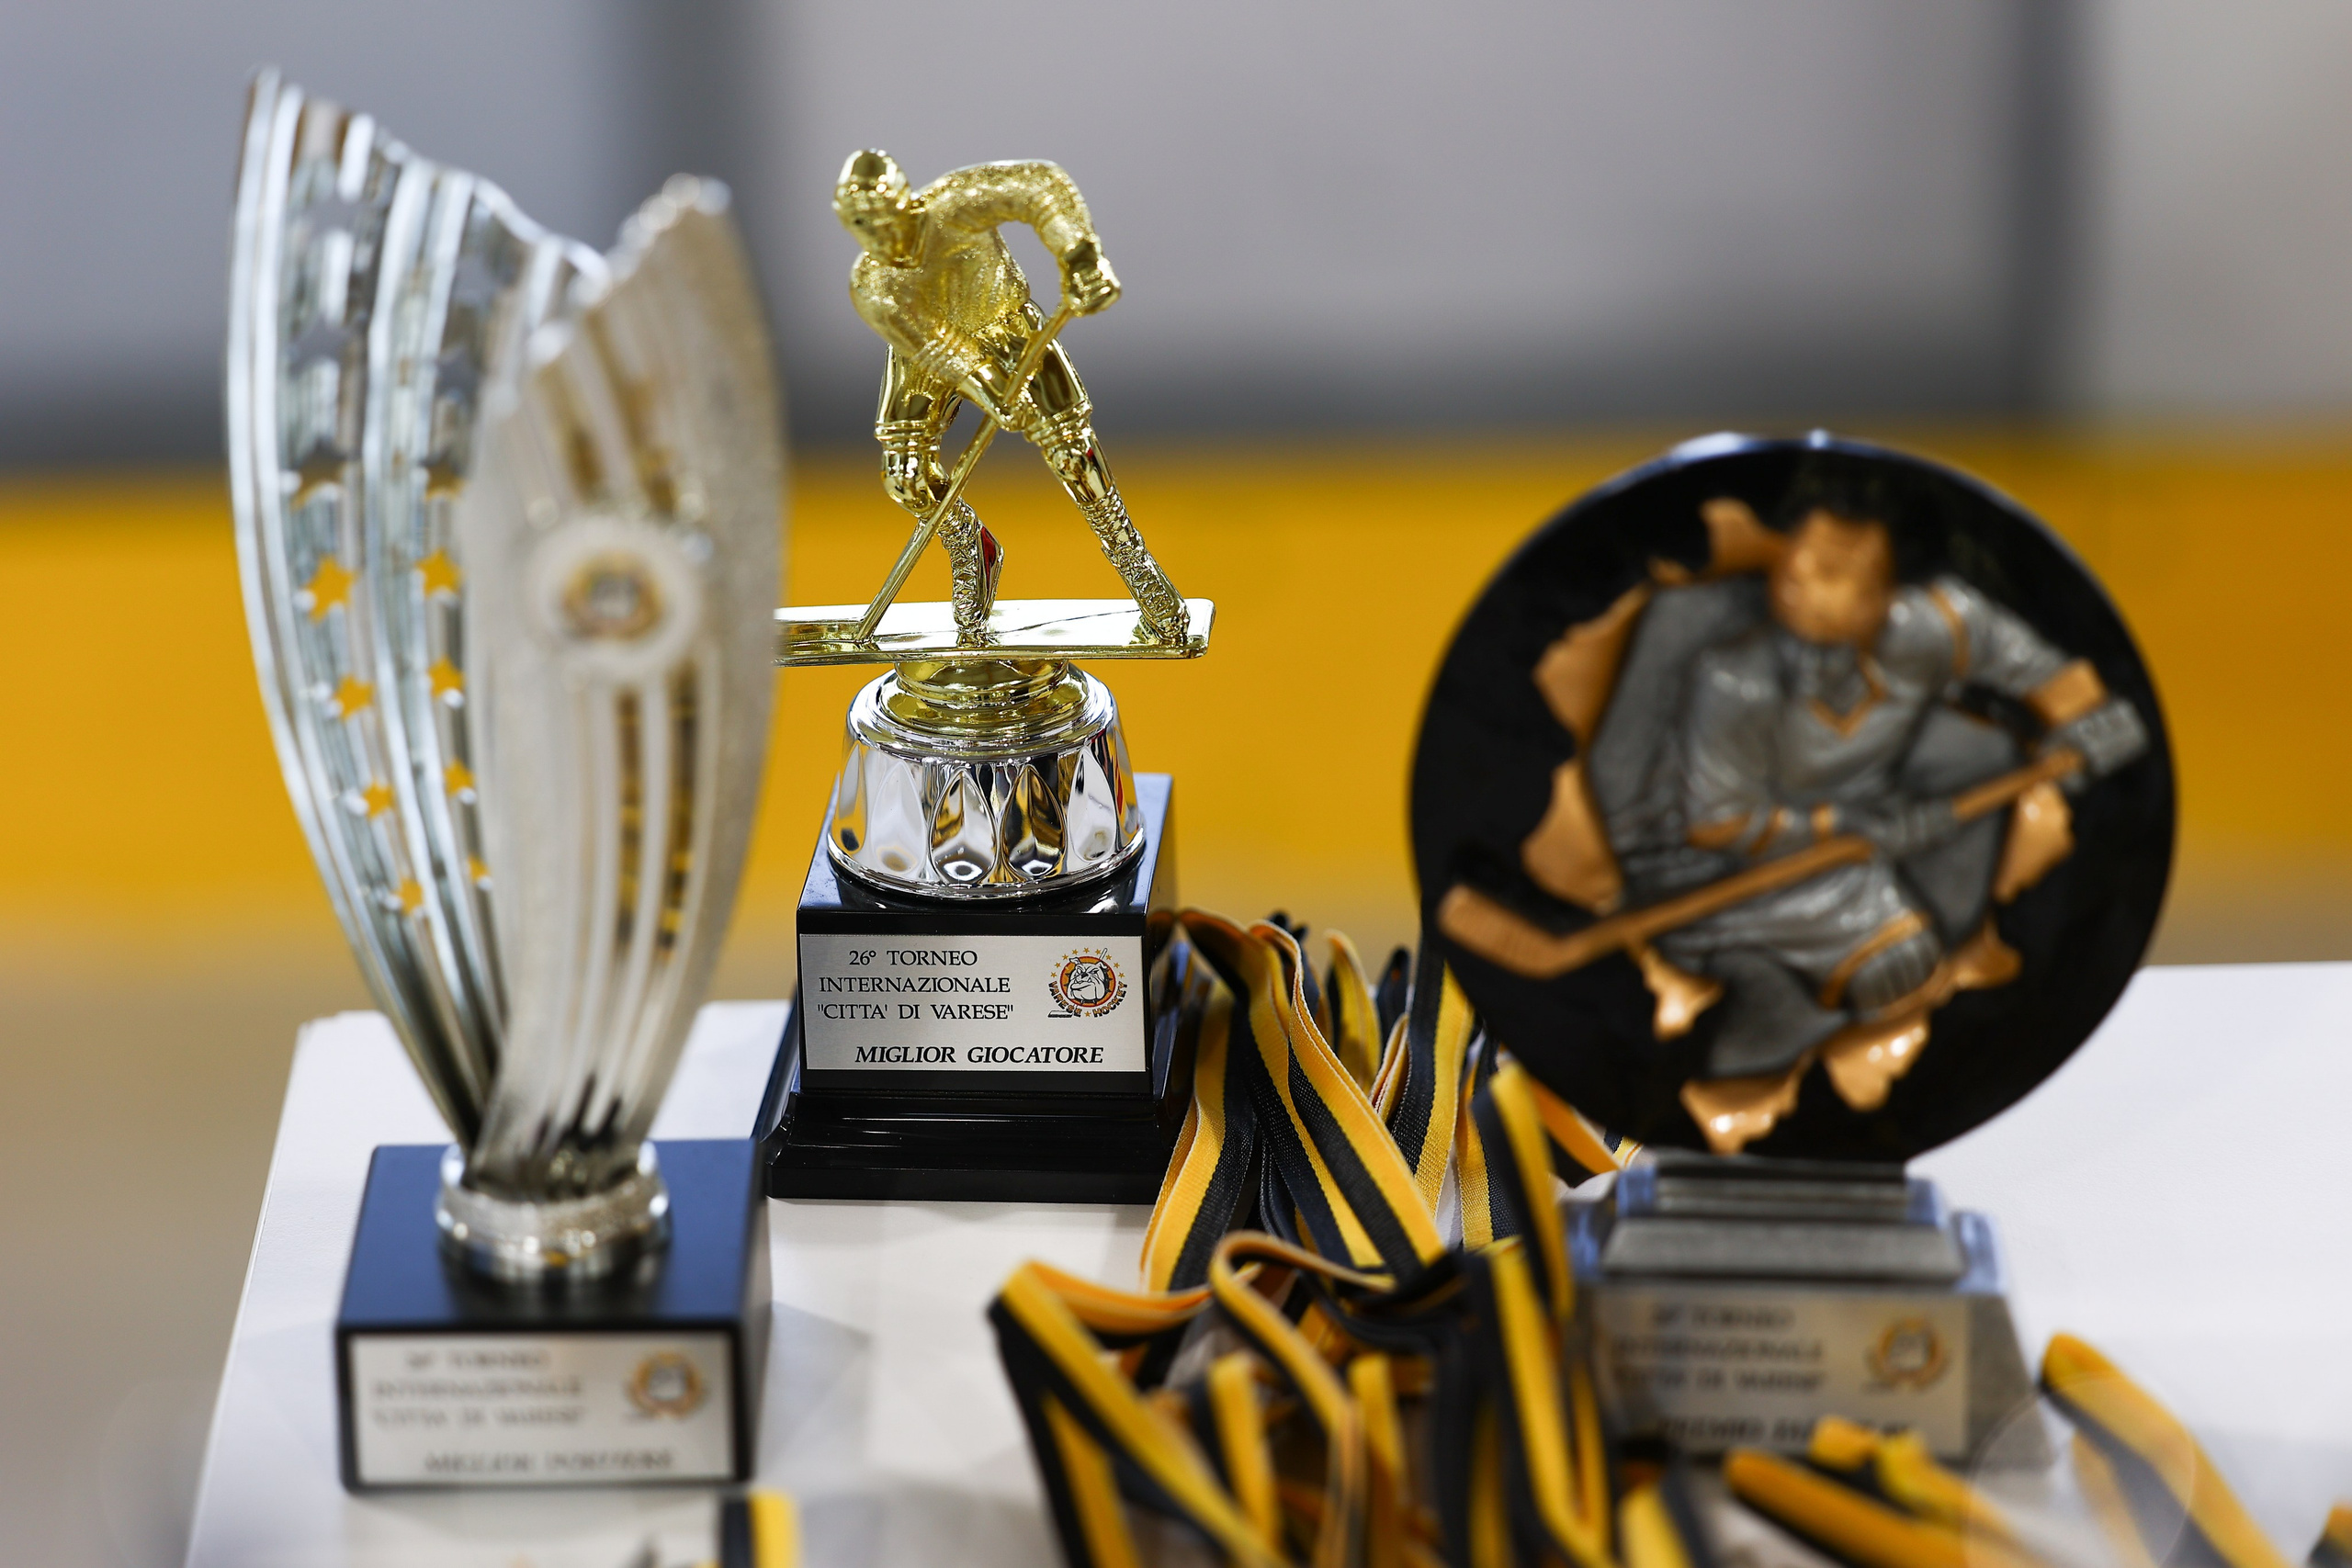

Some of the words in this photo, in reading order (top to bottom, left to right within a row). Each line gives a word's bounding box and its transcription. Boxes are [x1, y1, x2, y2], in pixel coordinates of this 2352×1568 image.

[888, 950, 978, 965] TORNEO
[819, 976, 1011, 993] INTERNAZIONALE
[1048, 980, 1082, 1018] VARESE
[1091, 980, 1128, 1018] HOCKEY
[818, 1004, 888, 1021] "CITTA'
[899, 1004, 921, 1020] DI
[931, 1004, 1013, 1021] VARESE"
[854, 1045, 956, 1064] MIGLIOR
[967, 1046, 1104, 1064] GIOCATORE
